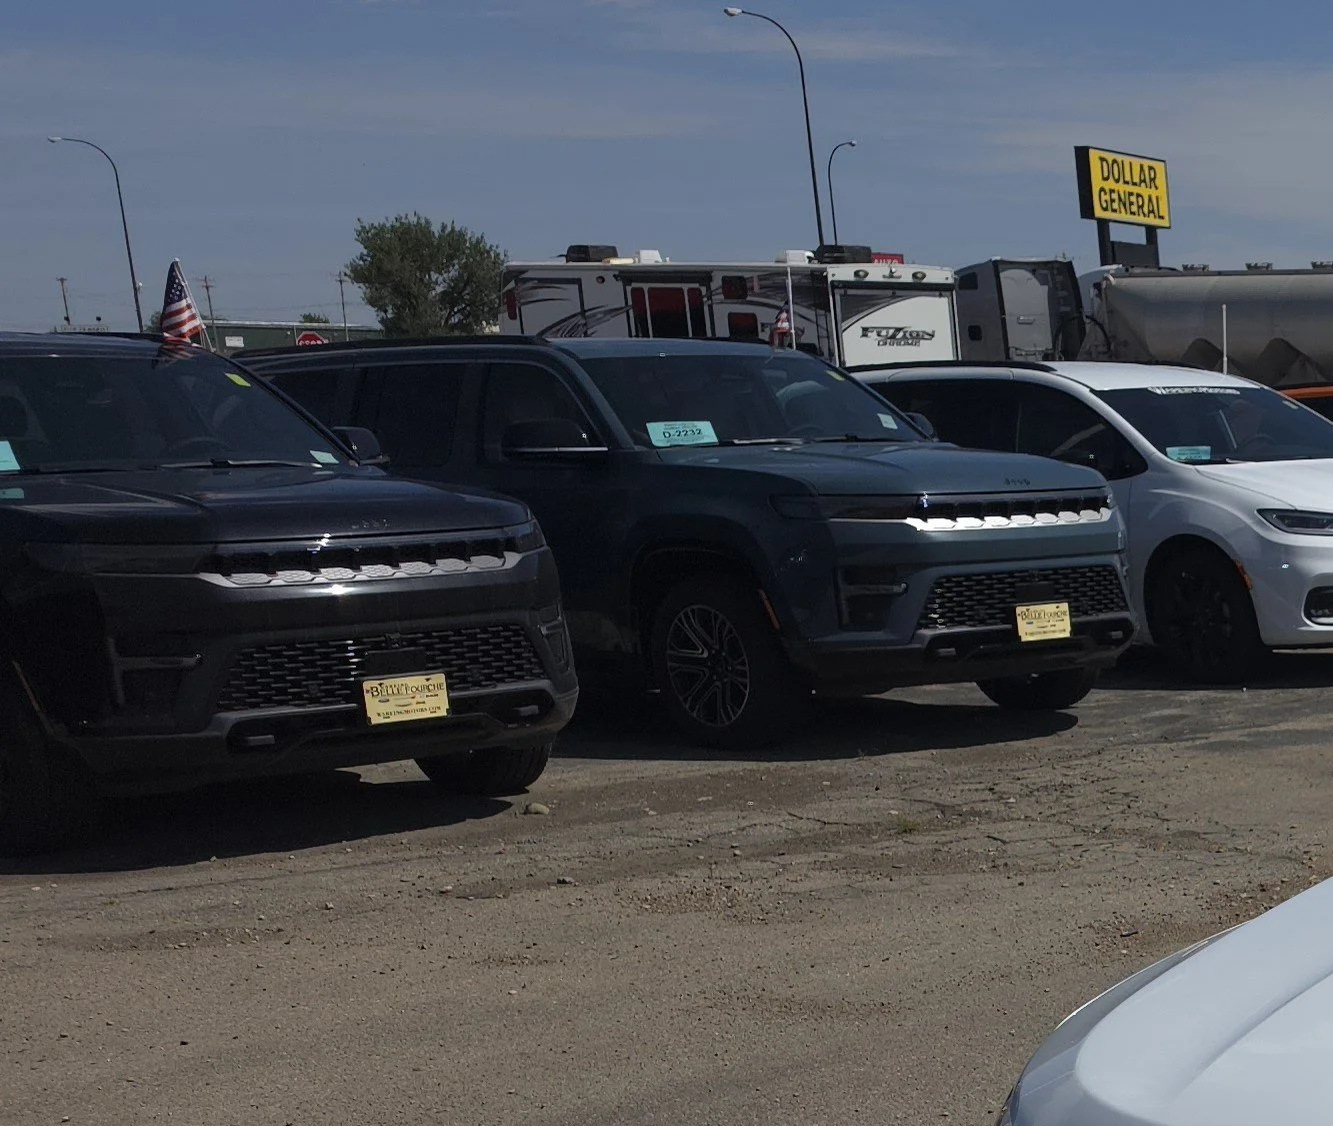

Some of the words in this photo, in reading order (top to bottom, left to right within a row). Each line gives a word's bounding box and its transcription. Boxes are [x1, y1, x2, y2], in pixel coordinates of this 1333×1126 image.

[1098, 155, 1159, 191] DOLLAR
[1098, 187, 1165, 220] GENERAL
[662, 428, 702, 439] D-2232
